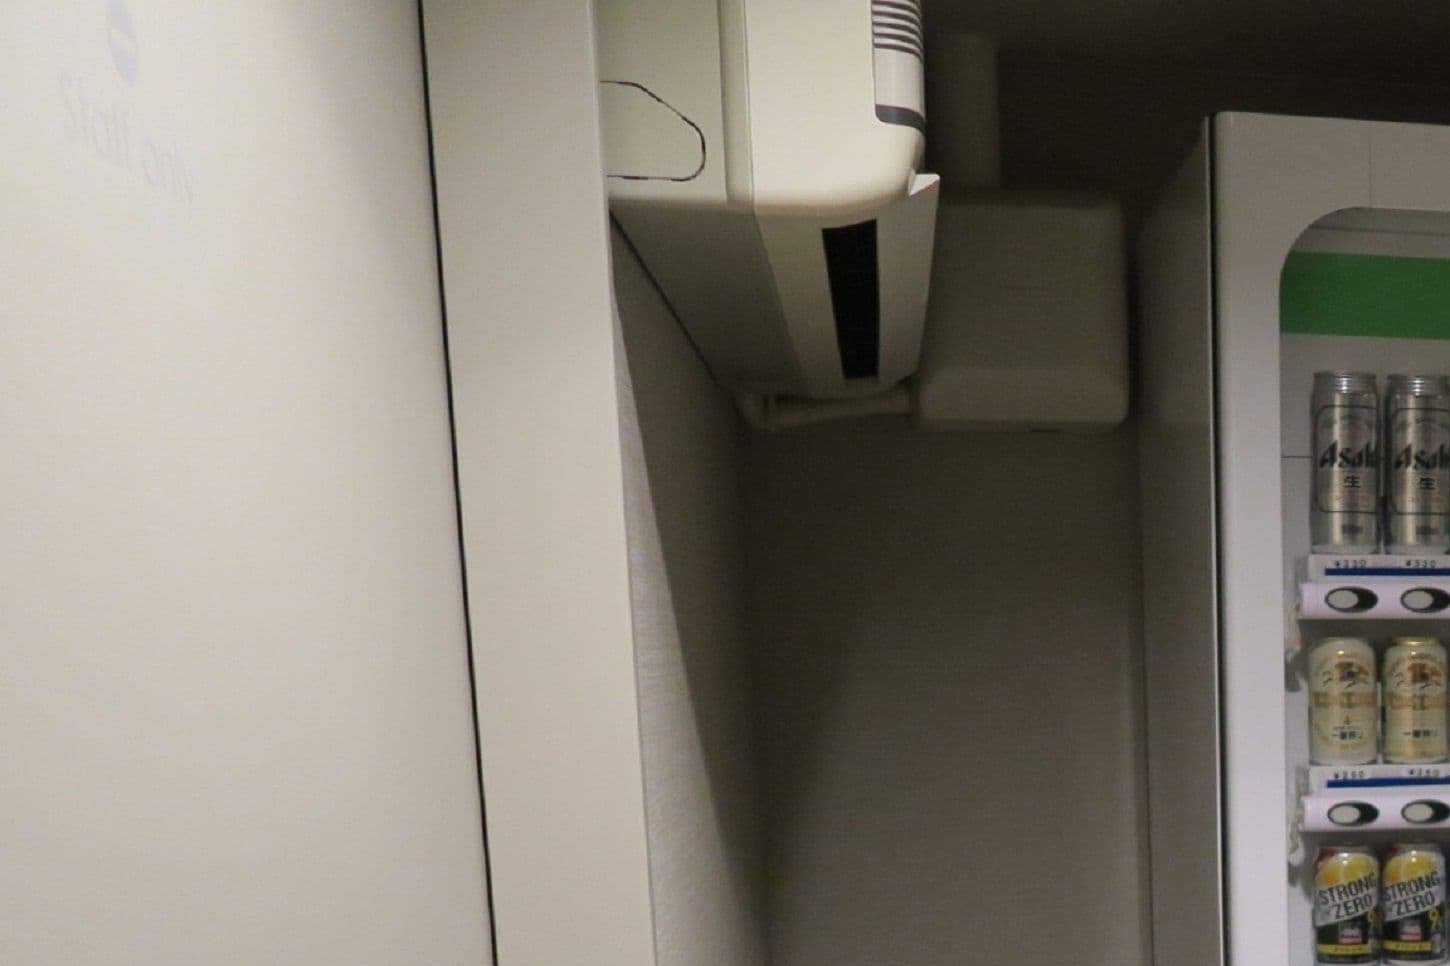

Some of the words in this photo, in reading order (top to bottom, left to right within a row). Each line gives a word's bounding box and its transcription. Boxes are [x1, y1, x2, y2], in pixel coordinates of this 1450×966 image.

[1318, 872, 1377, 906] STRONG
[1333, 893, 1373, 920] ZERO
[1392, 891, 1435, 918] ZERO
